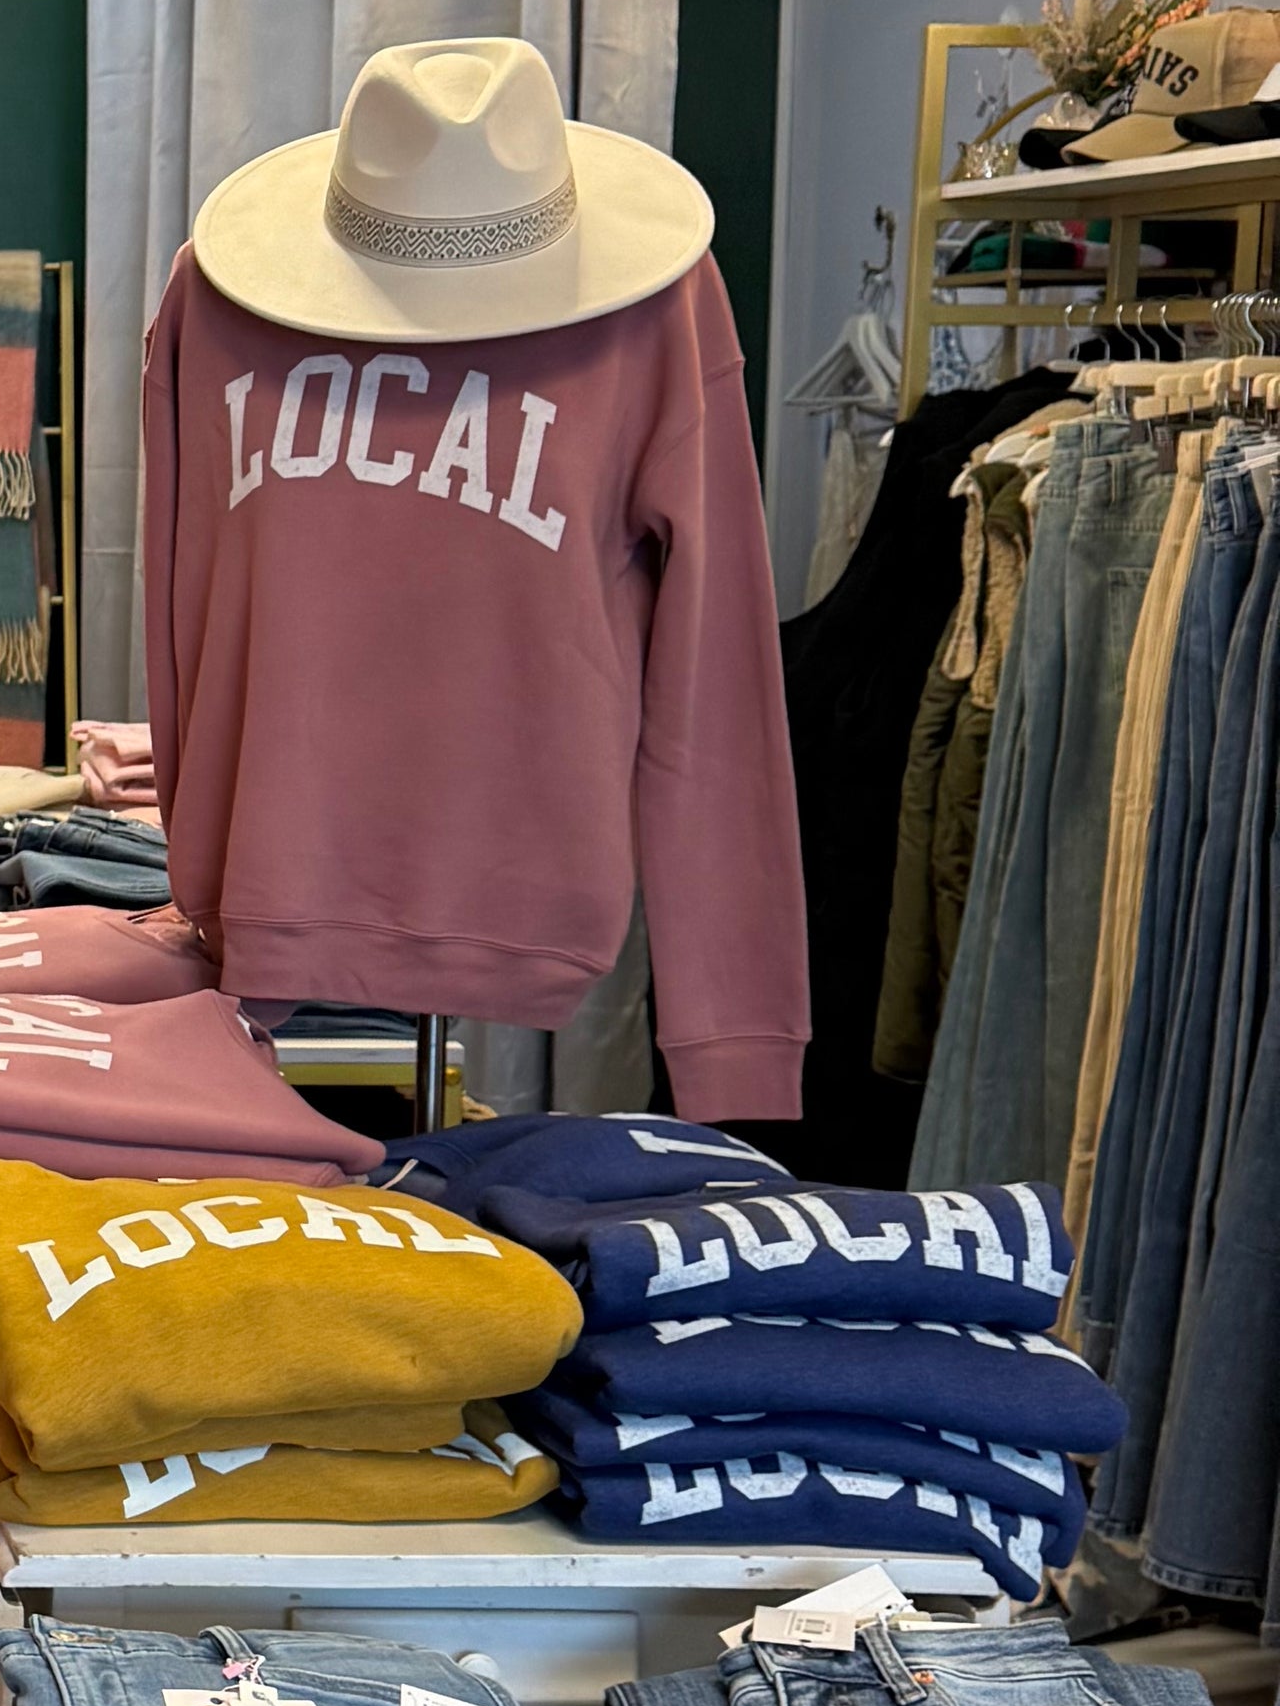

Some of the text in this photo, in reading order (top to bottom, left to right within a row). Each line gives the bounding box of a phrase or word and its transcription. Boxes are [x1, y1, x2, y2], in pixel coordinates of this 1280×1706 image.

[225, 353, 567, 552] LOCAL
[18, 1194, 503, 1323] LOCAL
[623, 1182, 1076, 1298] LOCAL
